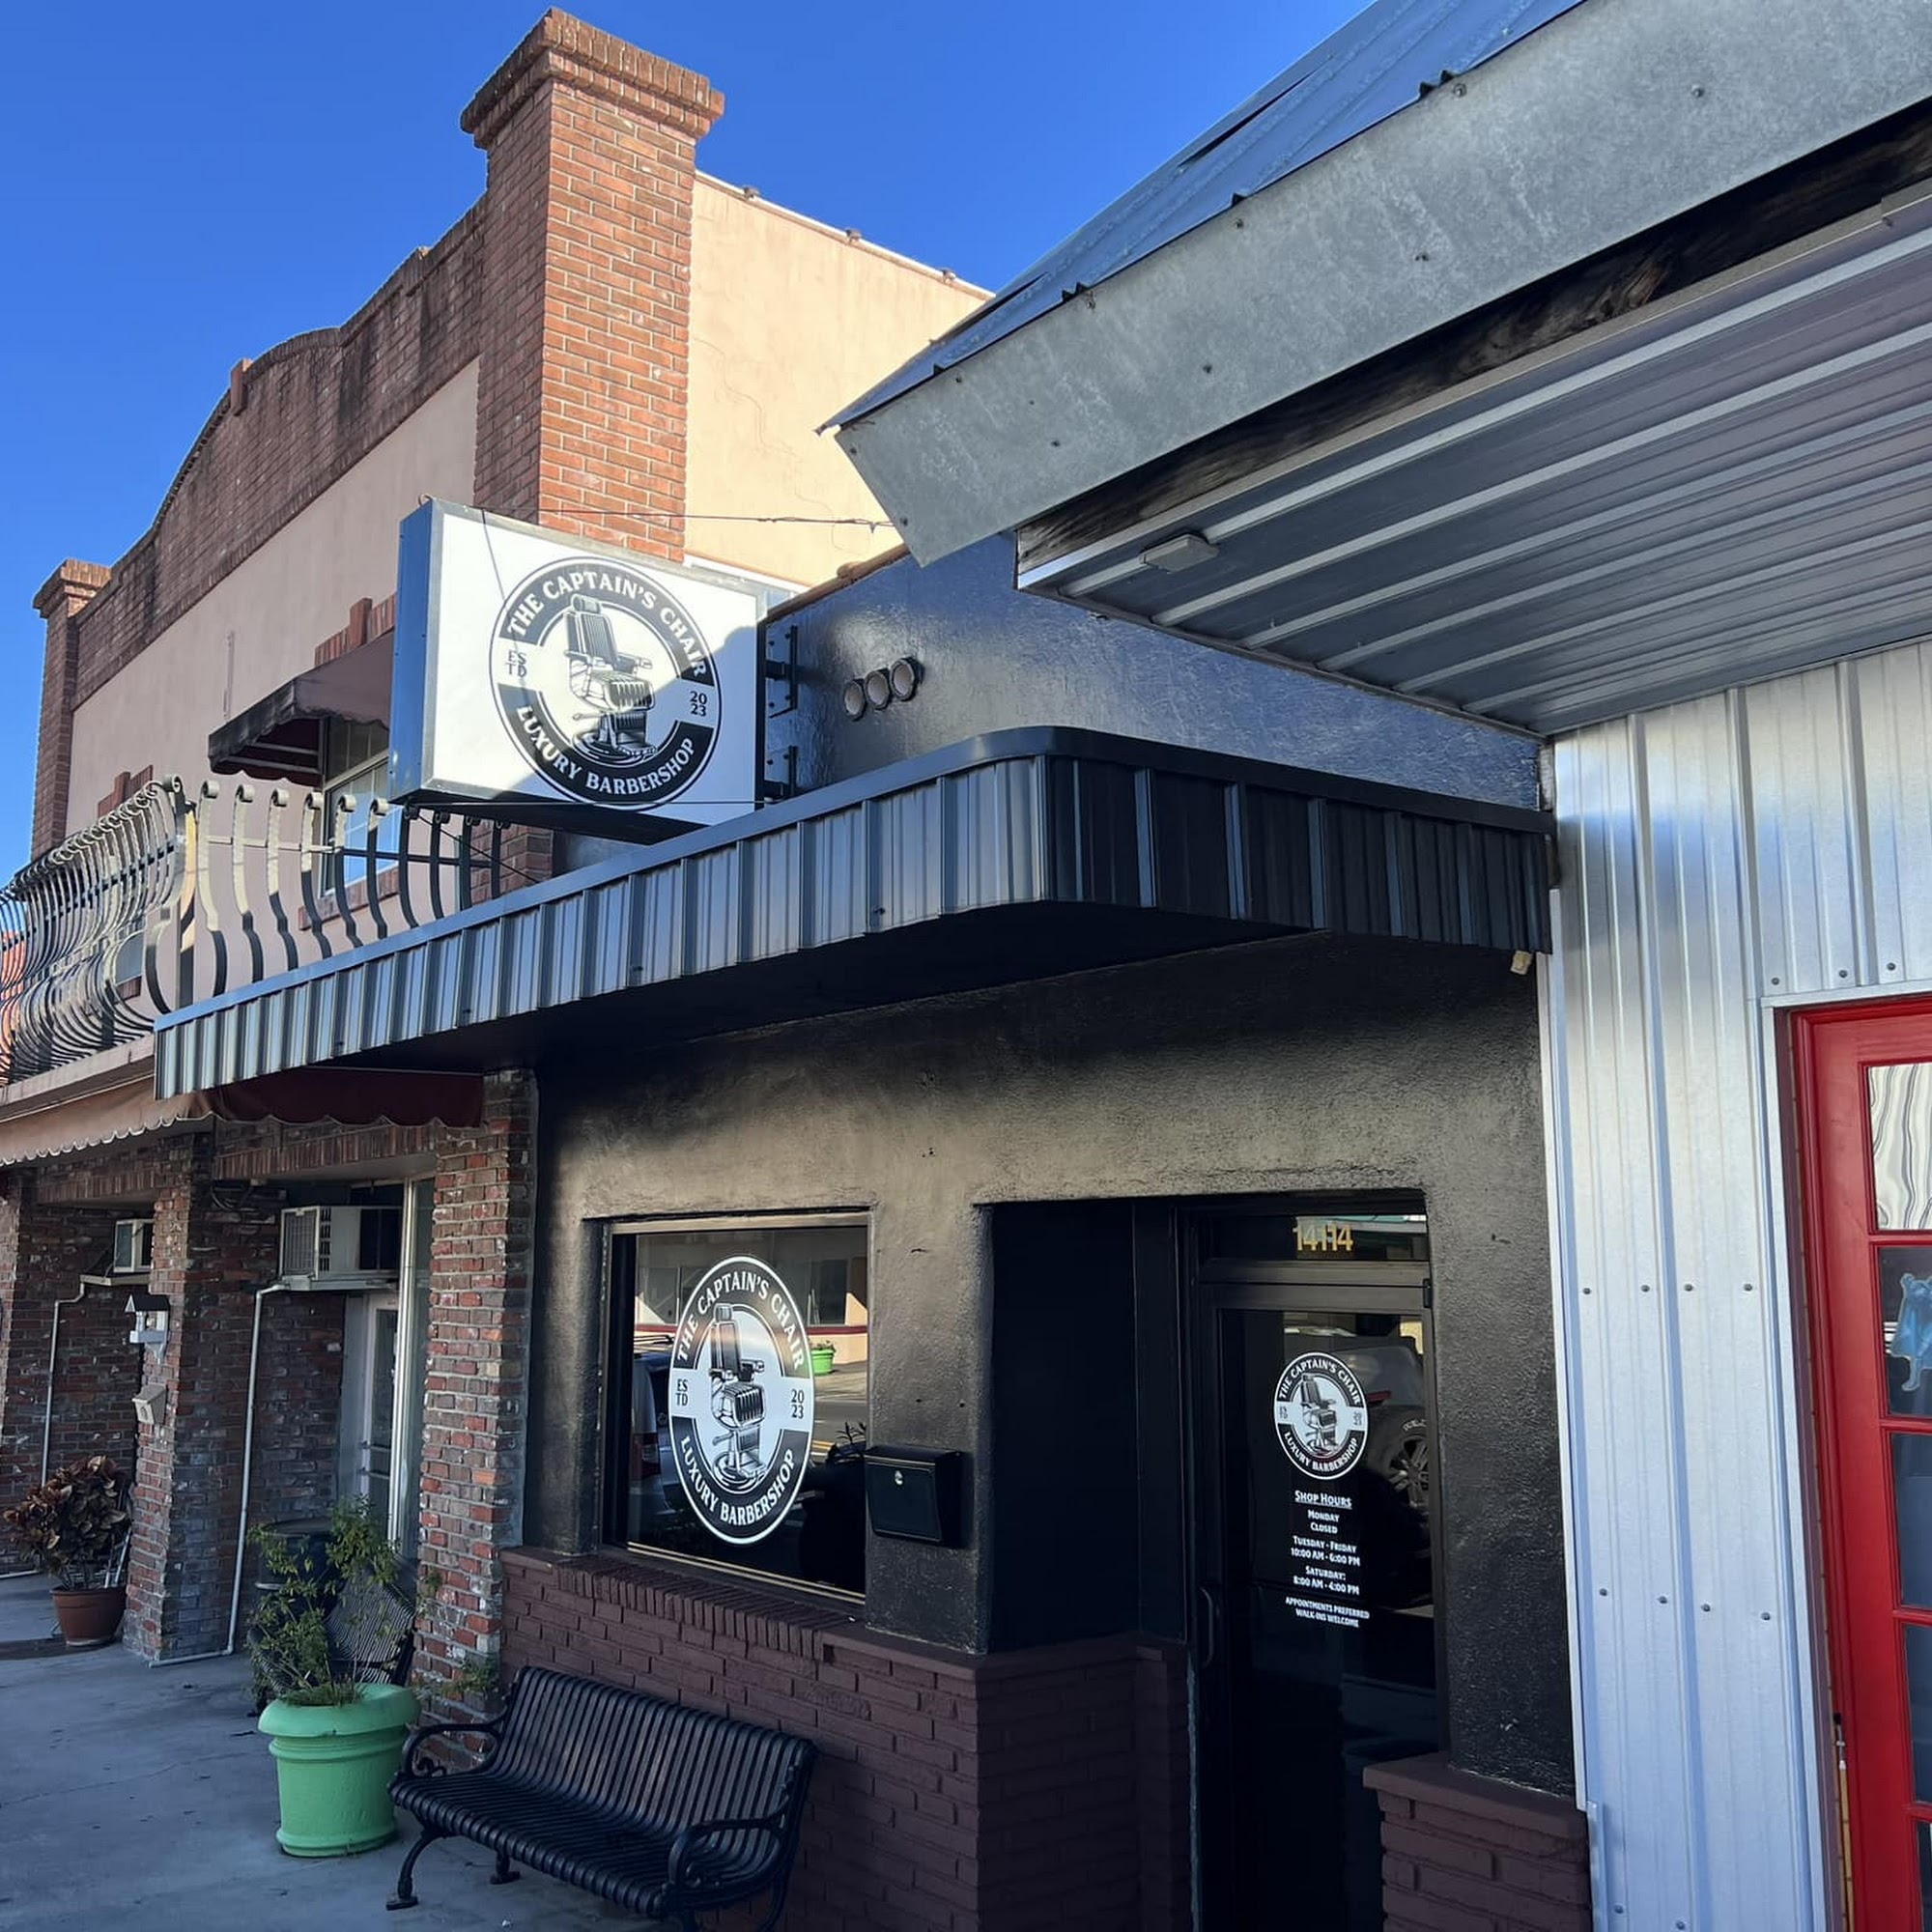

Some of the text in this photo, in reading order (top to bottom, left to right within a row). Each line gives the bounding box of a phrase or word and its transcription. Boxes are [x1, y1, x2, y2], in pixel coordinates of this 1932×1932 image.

[507, 571, 707, 677] THE CAPTAIN'S CHAIR
[690, 691, 707, 704] 20
[690, 704, 707, 717] 23
[517, 705, 695, 795] LUXURY BARBERSHOP
[677, 1270, 805, 1370] THE CAPTAIN'S CHAIR
[676, 1379, 688, 1393] ES
[1279, 1358, 1361, 1405] THE CAPTAIN'S CHAIR
[675, 1392, 688, 1406] TD
[791, 1388, 805, 1404] 20
[791, 1405, 805, 1419] 23
[1284, 1431, 1358, 1471] LUXURY BARBERSHOP
[681, 1436, 796, 1527] LUXURY BARBERSHOP
[1294, 1490, 1352, 1507] SHOP HOURS
[1307, 1509, 1340, 1522] MONDAY
[1310, 1521, 1338, 1534] CLOSED
[1293, 1535, 1325, 1548] TUESDAY
[1330, 1541, 1357, 1553] FRIDAY
[1291, 1548, 1311, 1558] 10:00
[1312, 1550, 1324, 1560] AM
[1348, 1556, 1360, 1567] PM
[1312, 1578, 1323, 1589] AM
[1347, 1584, 1360, 1595] PM
[1285, 1597, 1332, 1612] APPOINTMENTS
